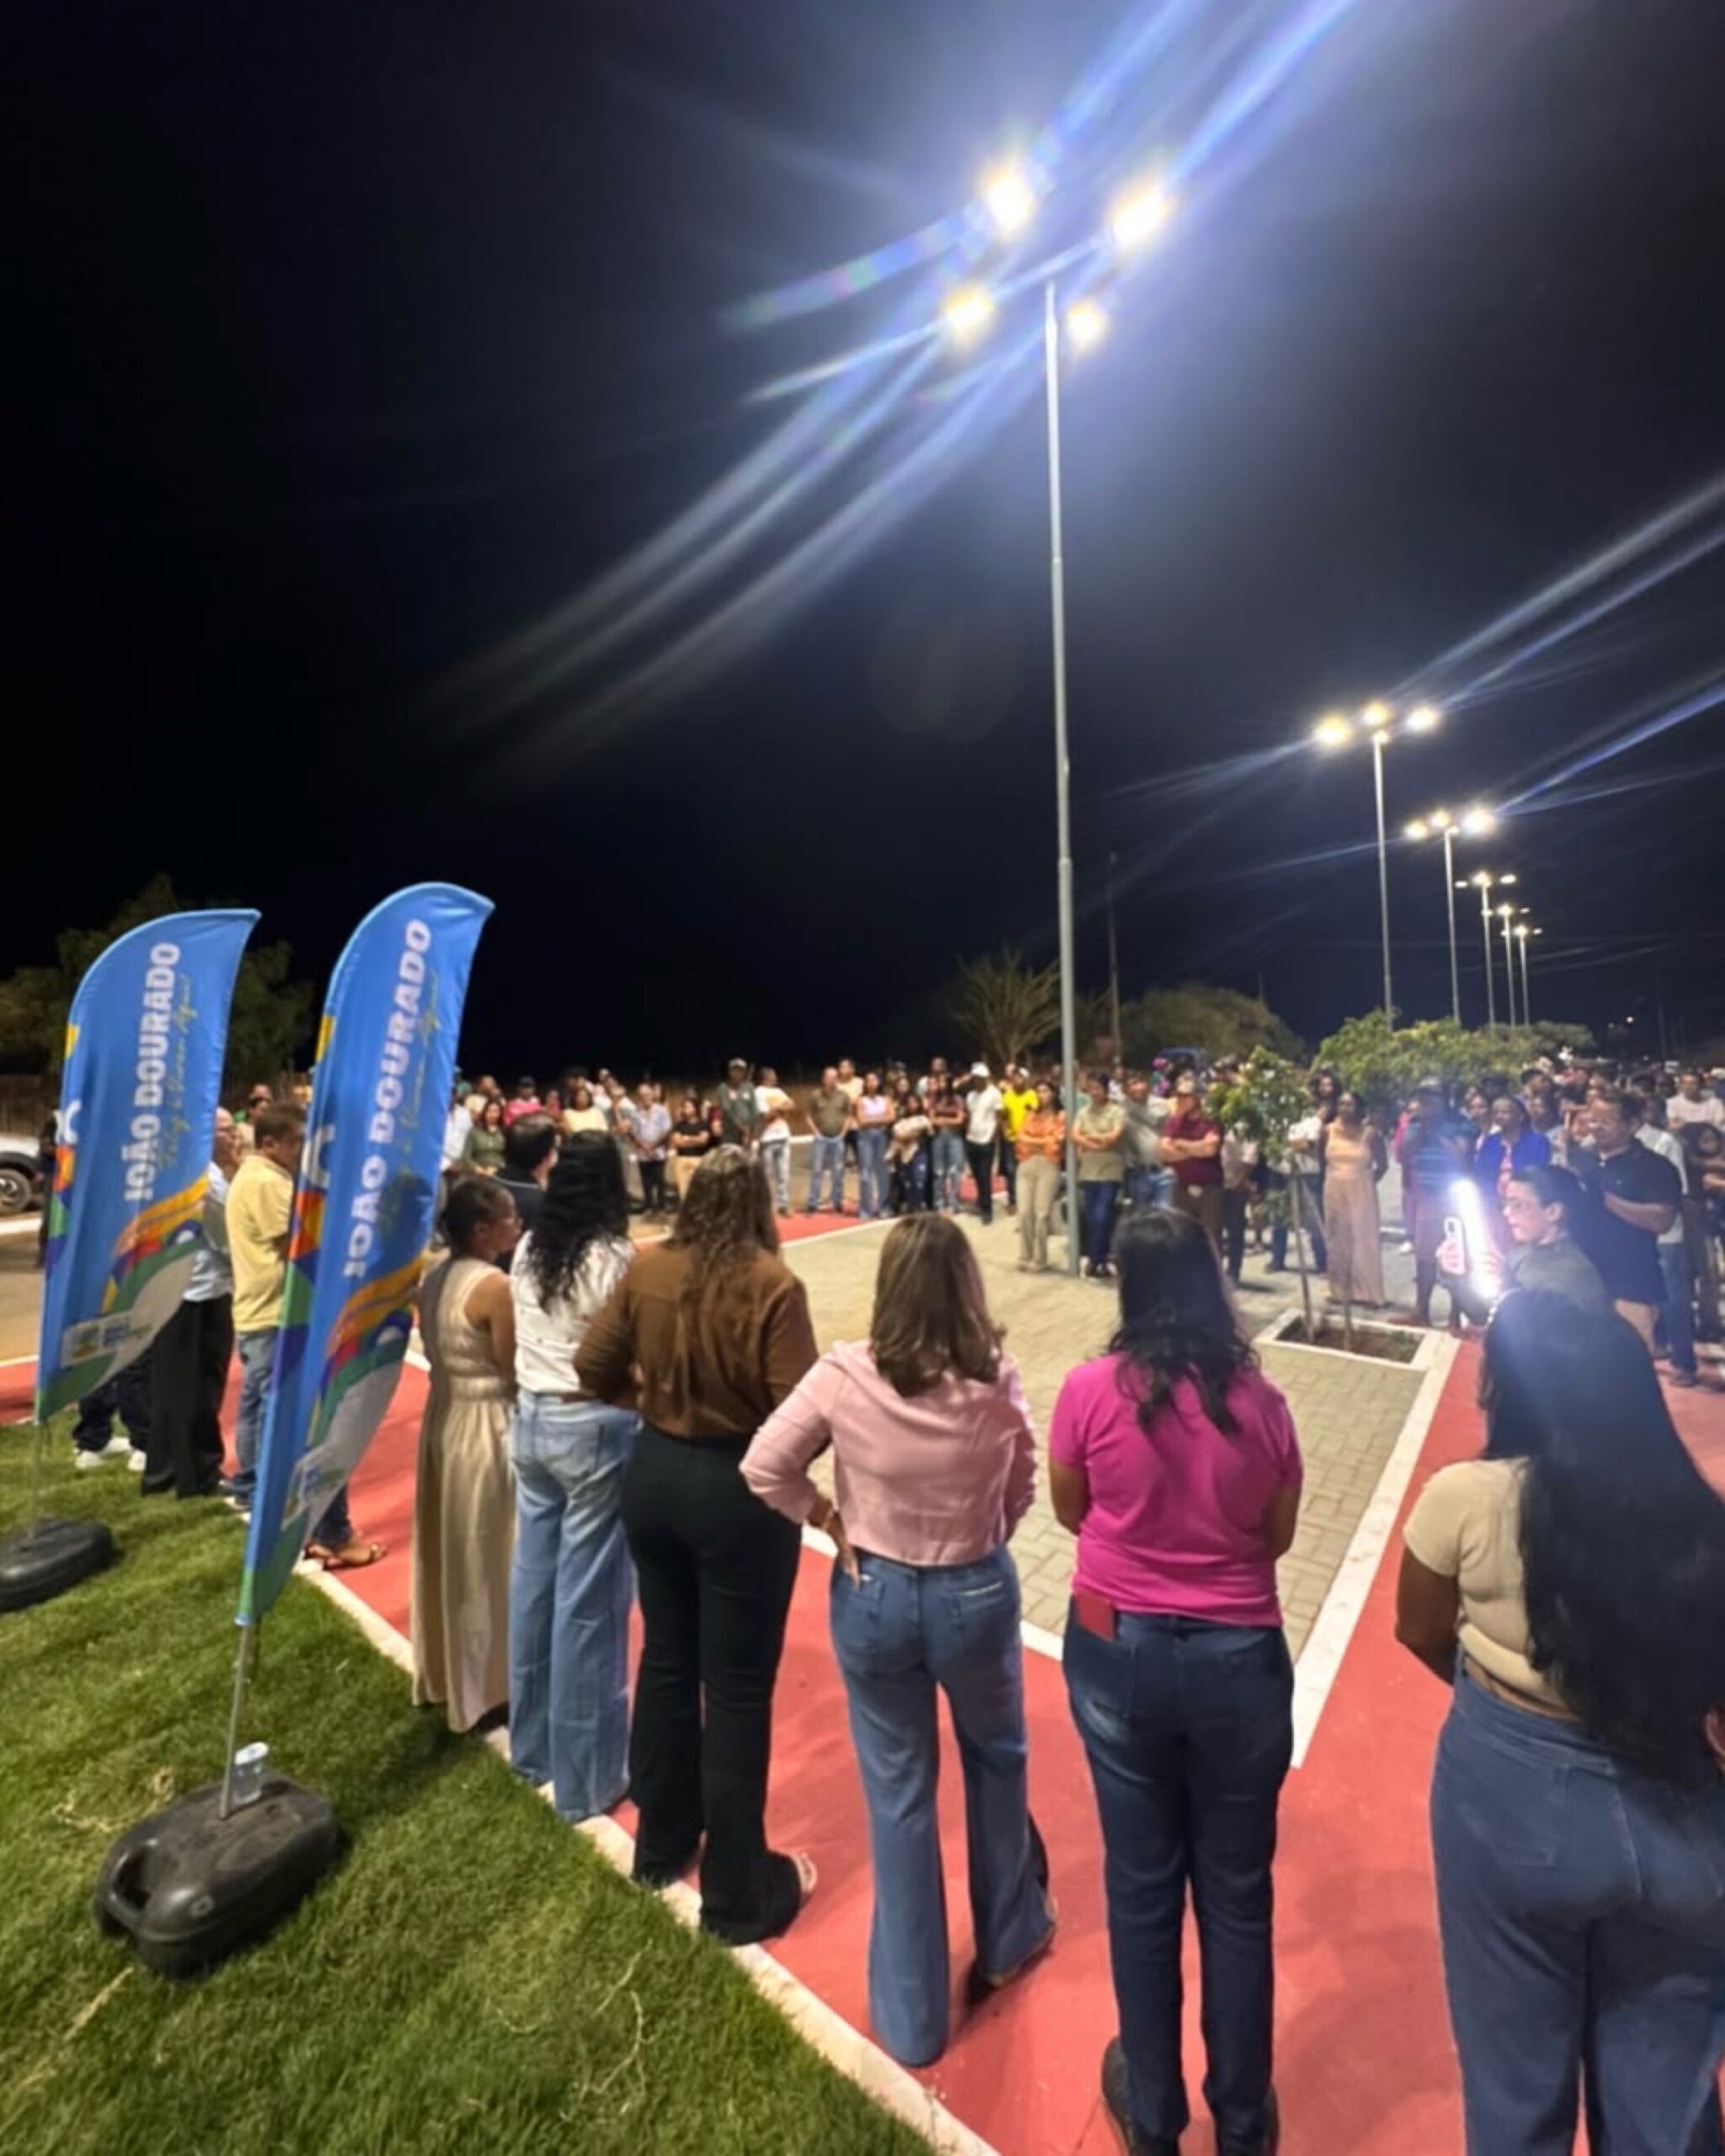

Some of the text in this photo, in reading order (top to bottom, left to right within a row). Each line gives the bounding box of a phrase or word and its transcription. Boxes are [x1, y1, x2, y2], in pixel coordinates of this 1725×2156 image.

[134, 942, 181, 1107] DOURADO
[369, 919, 431, 1145] DOURADO
[122, 1113, 161, 1201] JOÃO
